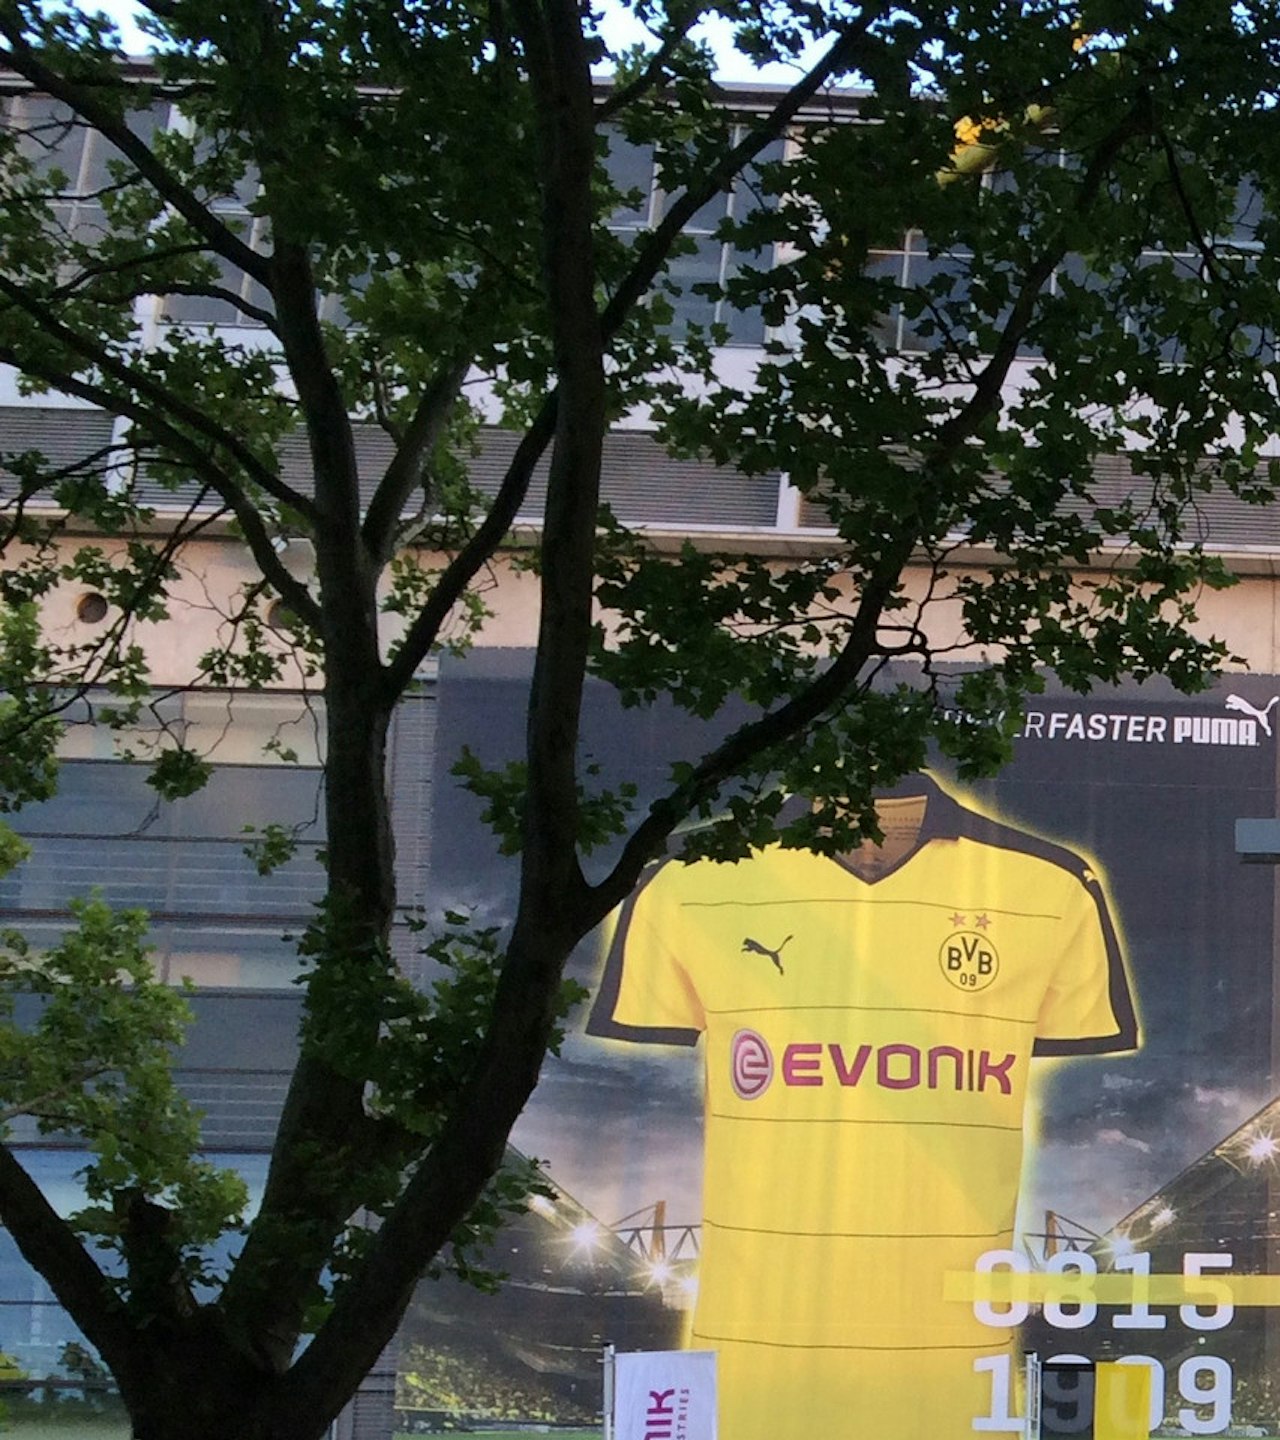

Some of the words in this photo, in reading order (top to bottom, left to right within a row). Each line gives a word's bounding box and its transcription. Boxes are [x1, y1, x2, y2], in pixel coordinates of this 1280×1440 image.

[1048, 714, 1166, 743] FASTER
[1173, 717, 1258, 746] PUMA
[948, 936, 993, 975] BVB
[959, 972, 977, 987] 09
[781, 1043, 1016, 1095] EVONIK
[972, 1249, 1235, 1331] 0815
[971, 1354, 1234, 1435] 1909
